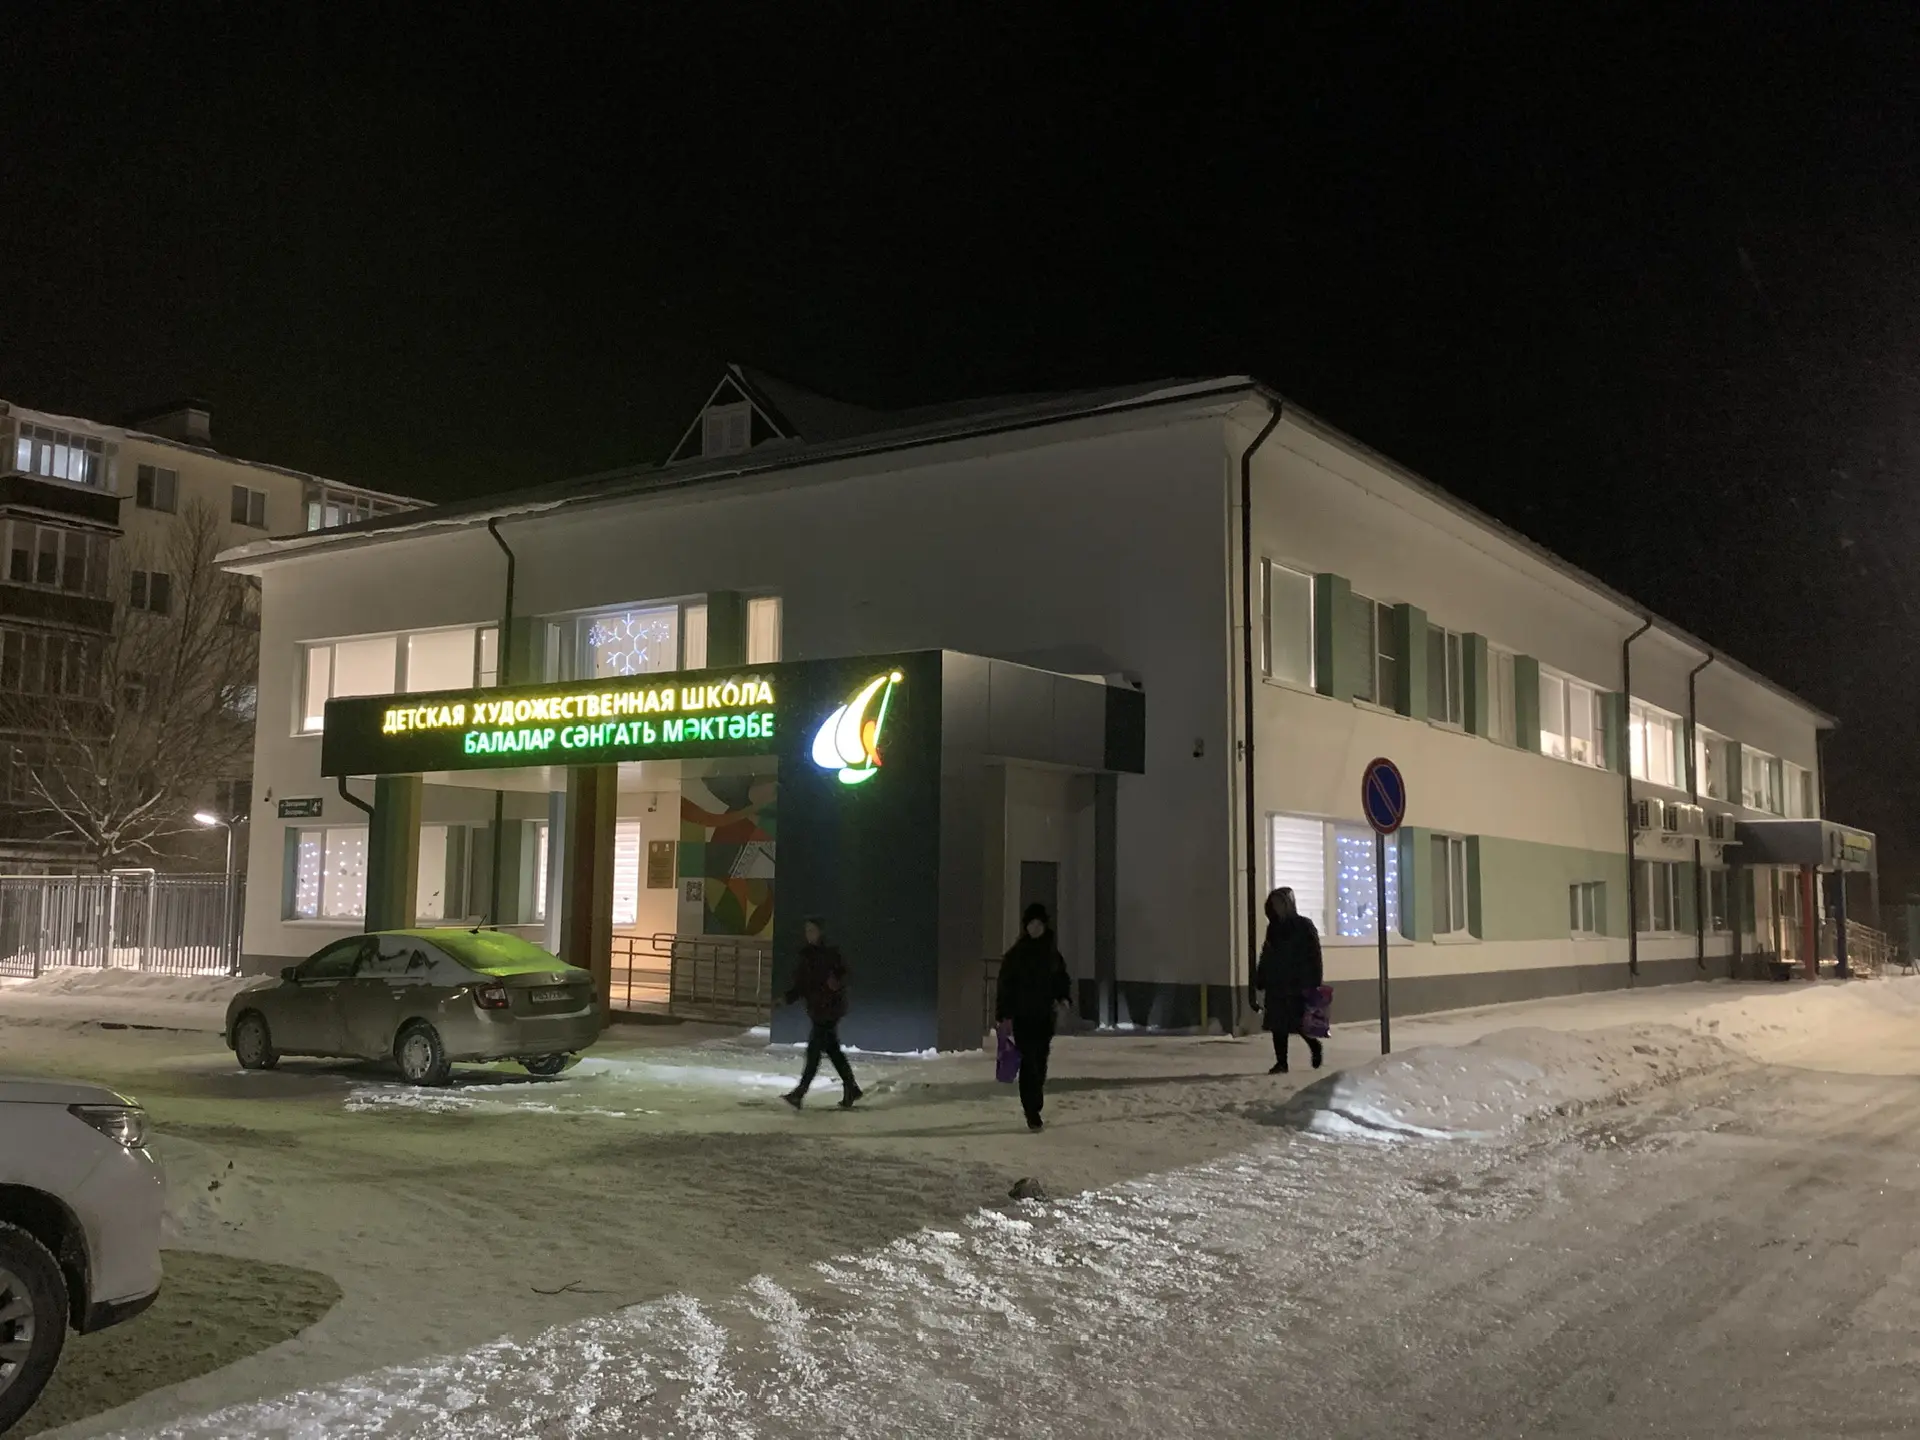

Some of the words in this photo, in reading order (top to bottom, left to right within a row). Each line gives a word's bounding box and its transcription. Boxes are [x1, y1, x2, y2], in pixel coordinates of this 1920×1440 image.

[382, 704, 466, 735] ДЕТСКАЯ
[472, 688, 675, 726] ХУДОЖЕСТВЕННАЯ
[681, 681, 775, 711] ШКОЛА
[463, 728, 556, 754] БАЛАЛАР
[560, 721, 656, 749] СӘНГАТЬ
[663, 713, 774, 743] МӘКТӘБЕ
